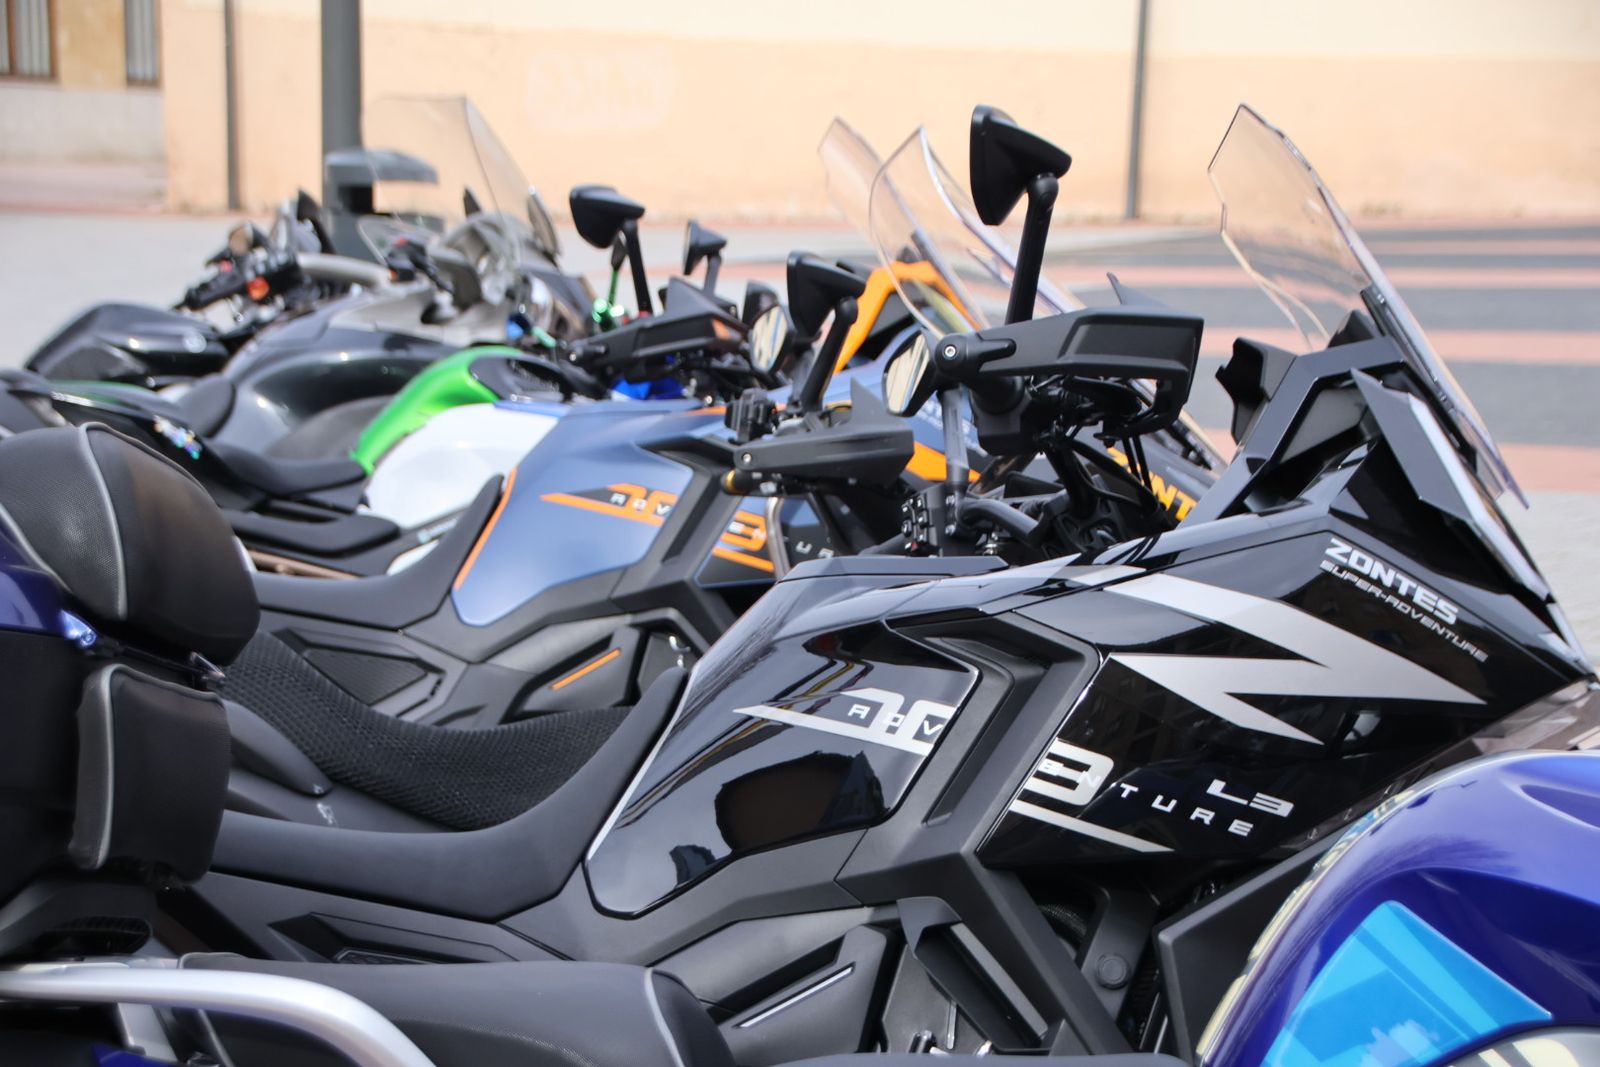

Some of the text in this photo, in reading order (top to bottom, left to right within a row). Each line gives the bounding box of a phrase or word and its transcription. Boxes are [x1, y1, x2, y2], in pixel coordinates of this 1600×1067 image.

[1320, 559, 1488, 662] SUPER-ADVENTURE
[1325, 537, 1458, 625] ZONTES
[847, 703, 944, 736] ADV
